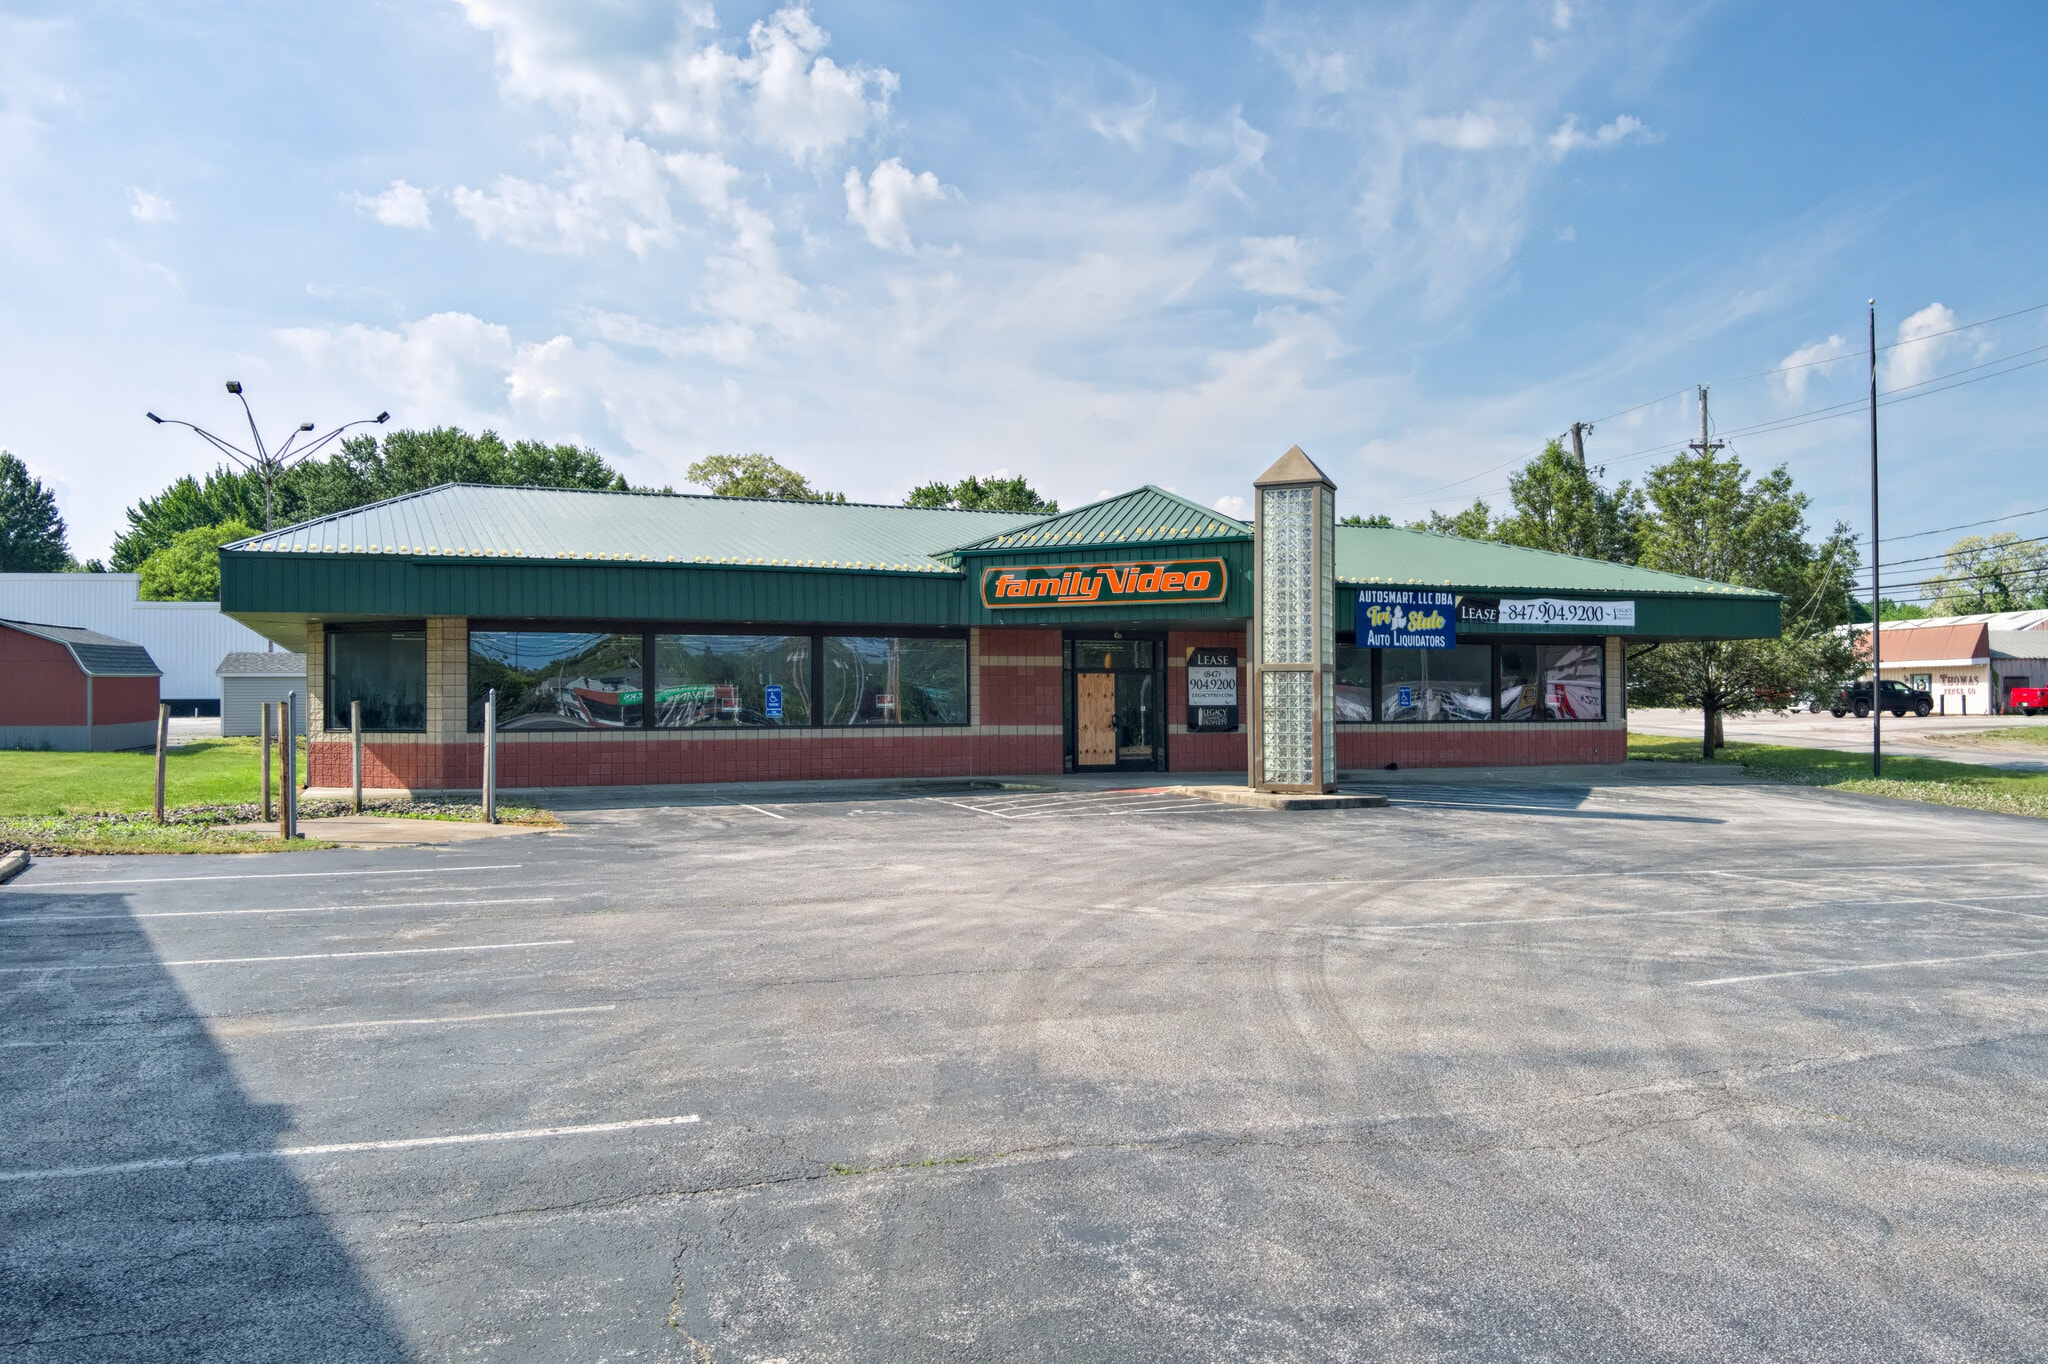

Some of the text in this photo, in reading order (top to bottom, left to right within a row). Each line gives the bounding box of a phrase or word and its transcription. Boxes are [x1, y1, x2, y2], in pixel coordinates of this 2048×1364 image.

[1359, 590, 1453, 605] AUTOSMART, LLC DBA
[1366, 605, 1446, 632] Tri State
[1461, 605, 1497, 620] LEASE
[1508, 604, 1603, 621] 847.904.9200
[1367, 629, 1446, 647] AUTO LIQUIDATORS
[1197, 654, 1229, 665] LEASE
[1189, 679, 1236, 690] 904.9200
[1940, 674, 1979, 686] THOMAS
